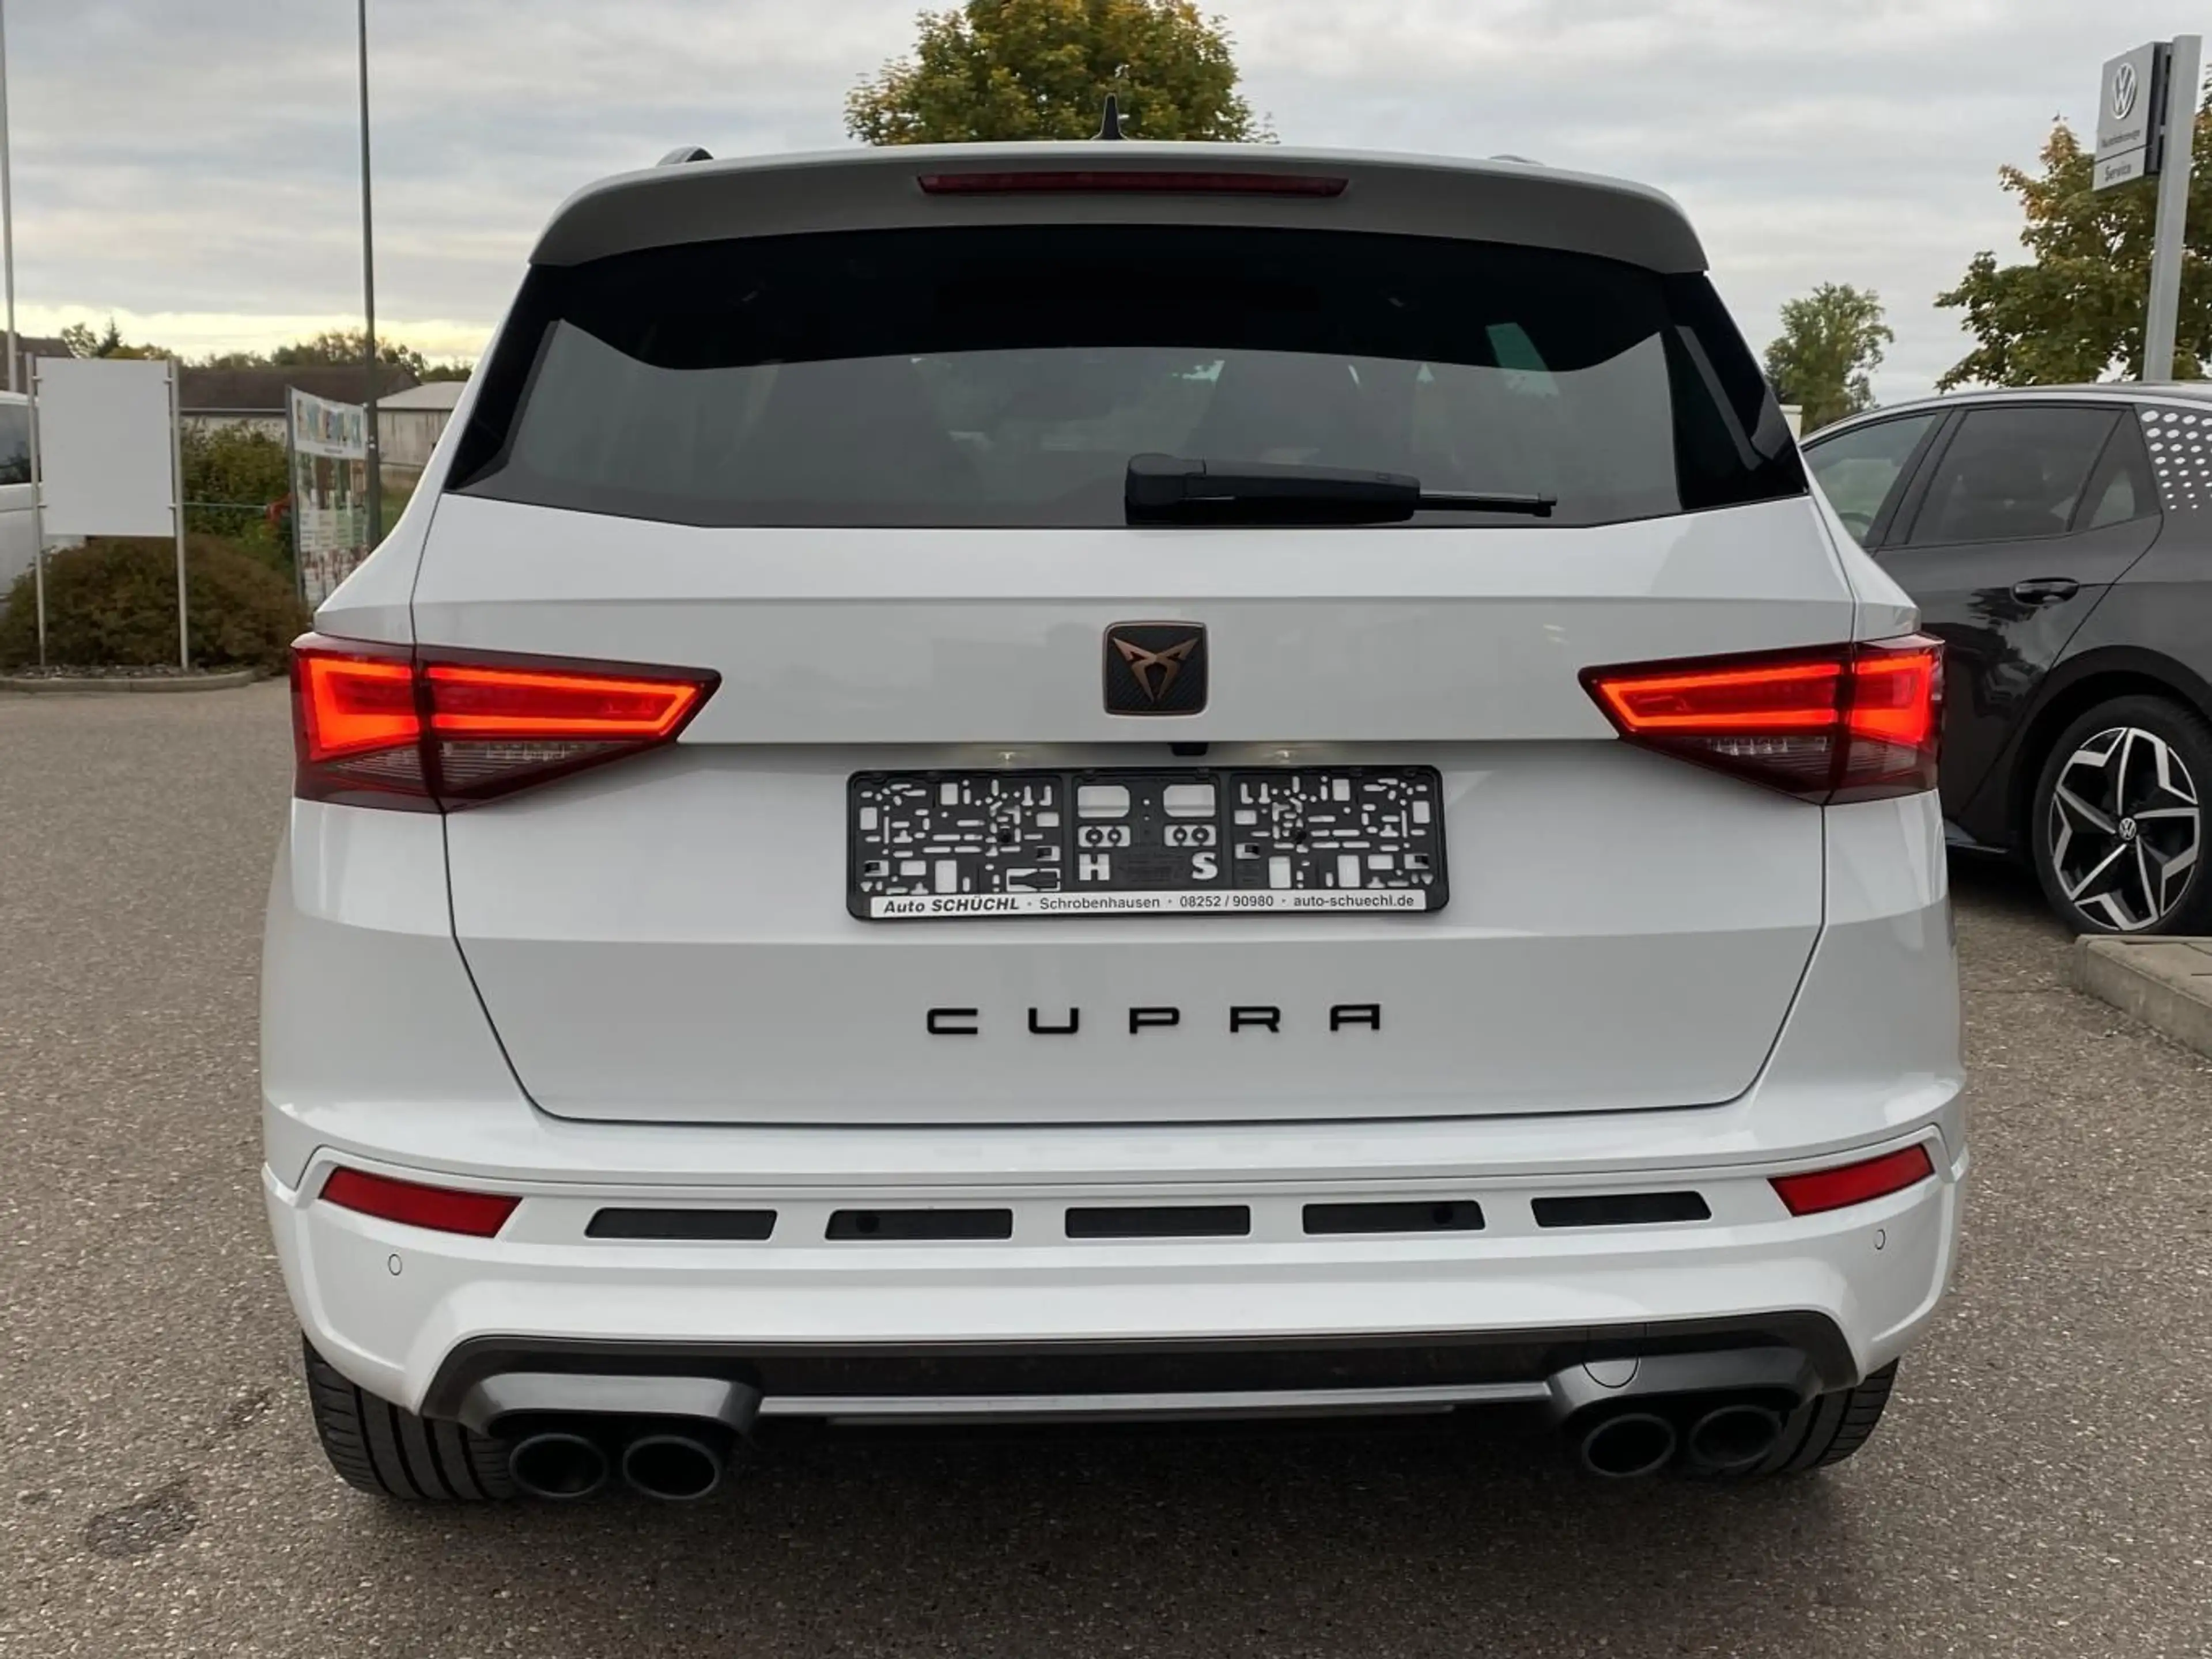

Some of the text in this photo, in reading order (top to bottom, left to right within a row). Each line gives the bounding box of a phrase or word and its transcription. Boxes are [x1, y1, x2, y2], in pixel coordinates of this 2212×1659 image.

[1079, 854, 1110, 880] H
[1192, 852, 1218, 880] S
[884, 895, 1020, 914] Auto SCHÜCHL
[1039, 897, 1160, 910] Schrobenhausen
[1179, 895, 1221, 908] 08252
[1232, 895, 1274, 907] 90980
[1294, 894, 1415, 907] auto-schuechl.de
[927, 1003, 1381, 1035] CUPRA
